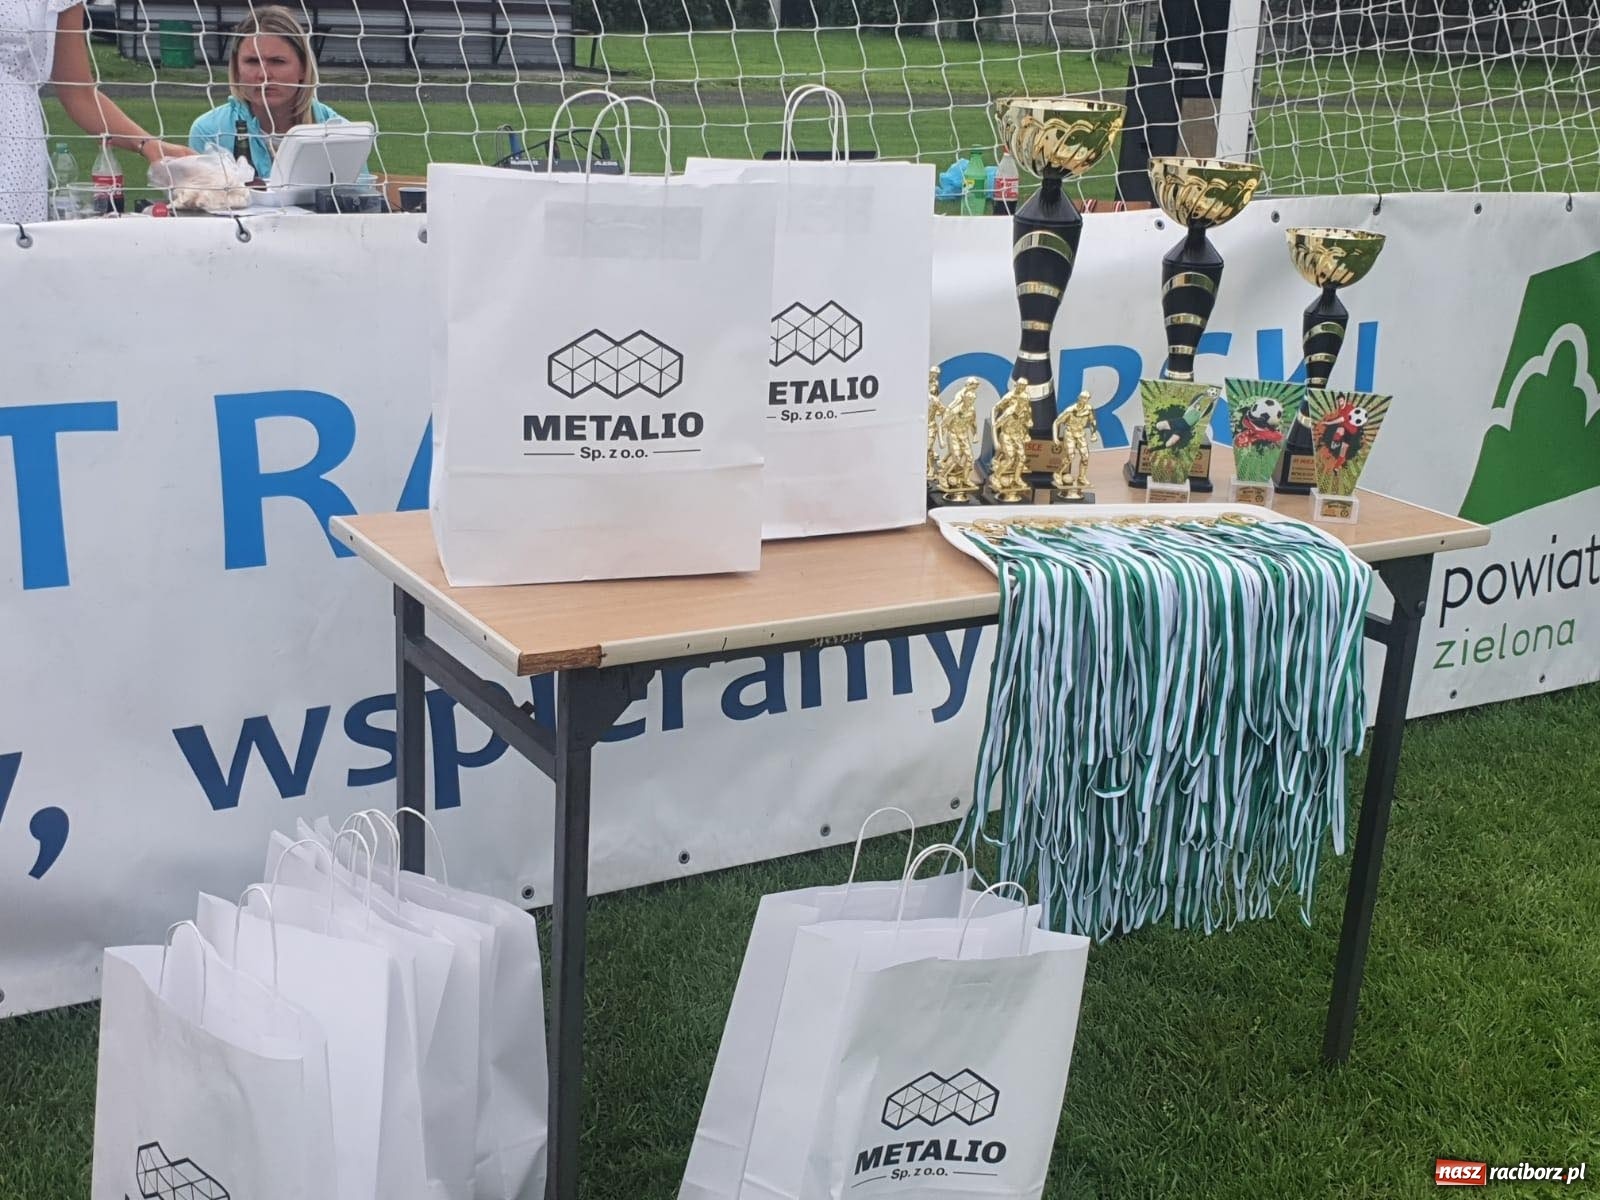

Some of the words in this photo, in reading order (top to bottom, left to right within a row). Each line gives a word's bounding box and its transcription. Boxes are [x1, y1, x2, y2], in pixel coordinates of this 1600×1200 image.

[768, 375, 879, 405] ETALIO
[523, 411, 704, 441] METALIO
[780, 409, 802, 424] Sp.
[805, 411, 812, 420] z
[814, 410, 837, 420] o.o.
[580, 446, 606, 462] Sp.
[609, 449, 618, 459] z
[620, 448, 648, 460] o.o.
[1439, 534, 1600, 629] powiat
[1433, 618, 1575, 669] zielona
[854, 1138, 1007, 1175] METALIO
[890, 1168, 911, 1181] Sp.
[914, 1168, 921, 1177] z
[923, 1167, 948, 1177] o.o.
